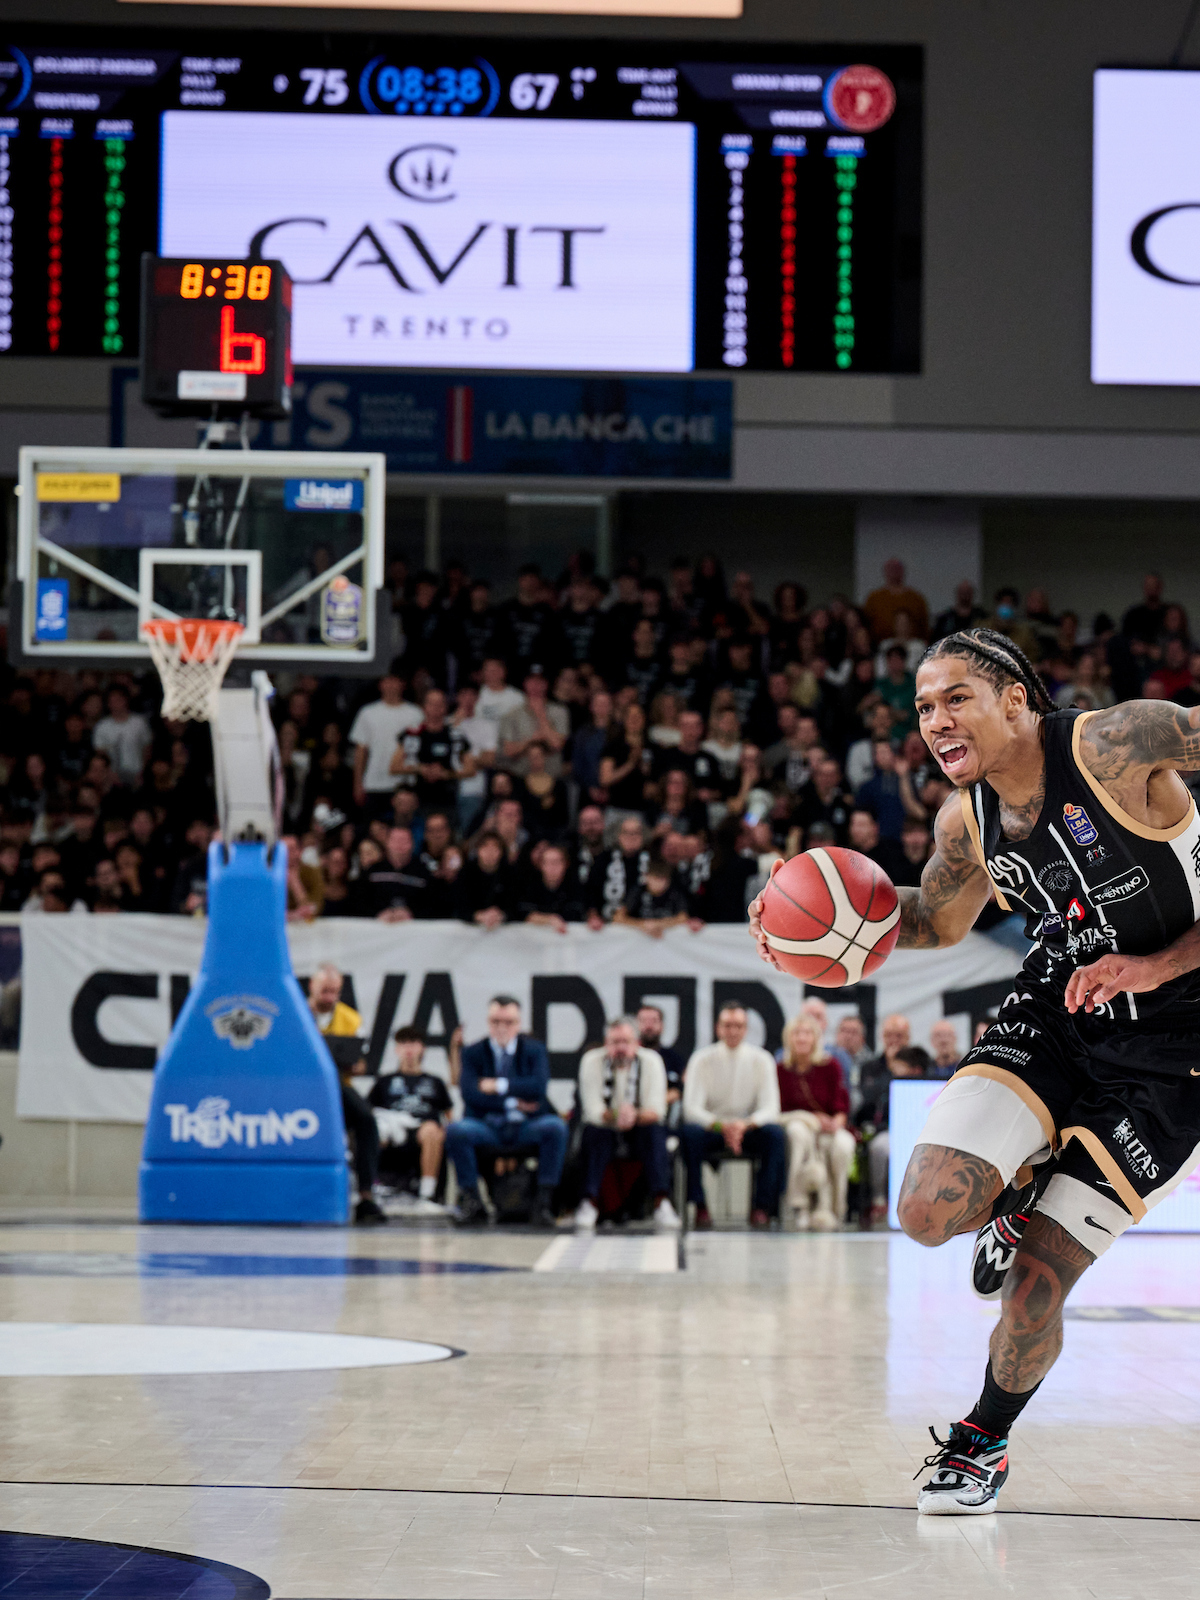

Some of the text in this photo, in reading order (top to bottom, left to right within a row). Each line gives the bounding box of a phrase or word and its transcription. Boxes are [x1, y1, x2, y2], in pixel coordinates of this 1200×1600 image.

[300, 68, 350, 105] 75
[376, 66, 482, 104] 08:38
[509, 72, 560, 110] 67
[248, 216, 605, 293] CAVIT
[345, 315, 509, 339] TRENTO
[486, 410, 715, 444] LA BANCA CHE
[1070, 817, 1088, 831] LBA
[1079, 830, 1095, 842] Unipol
[1094, 876, 1141, 901] TRENTINO
[981, 1021, 1042, 1040] AVIT
[164, 1102, 320, 1149] TRENTINO
[1123, 1147, 1144, 1179] MUTUA
[1126, 1137, 1160, 1180] ITAS
